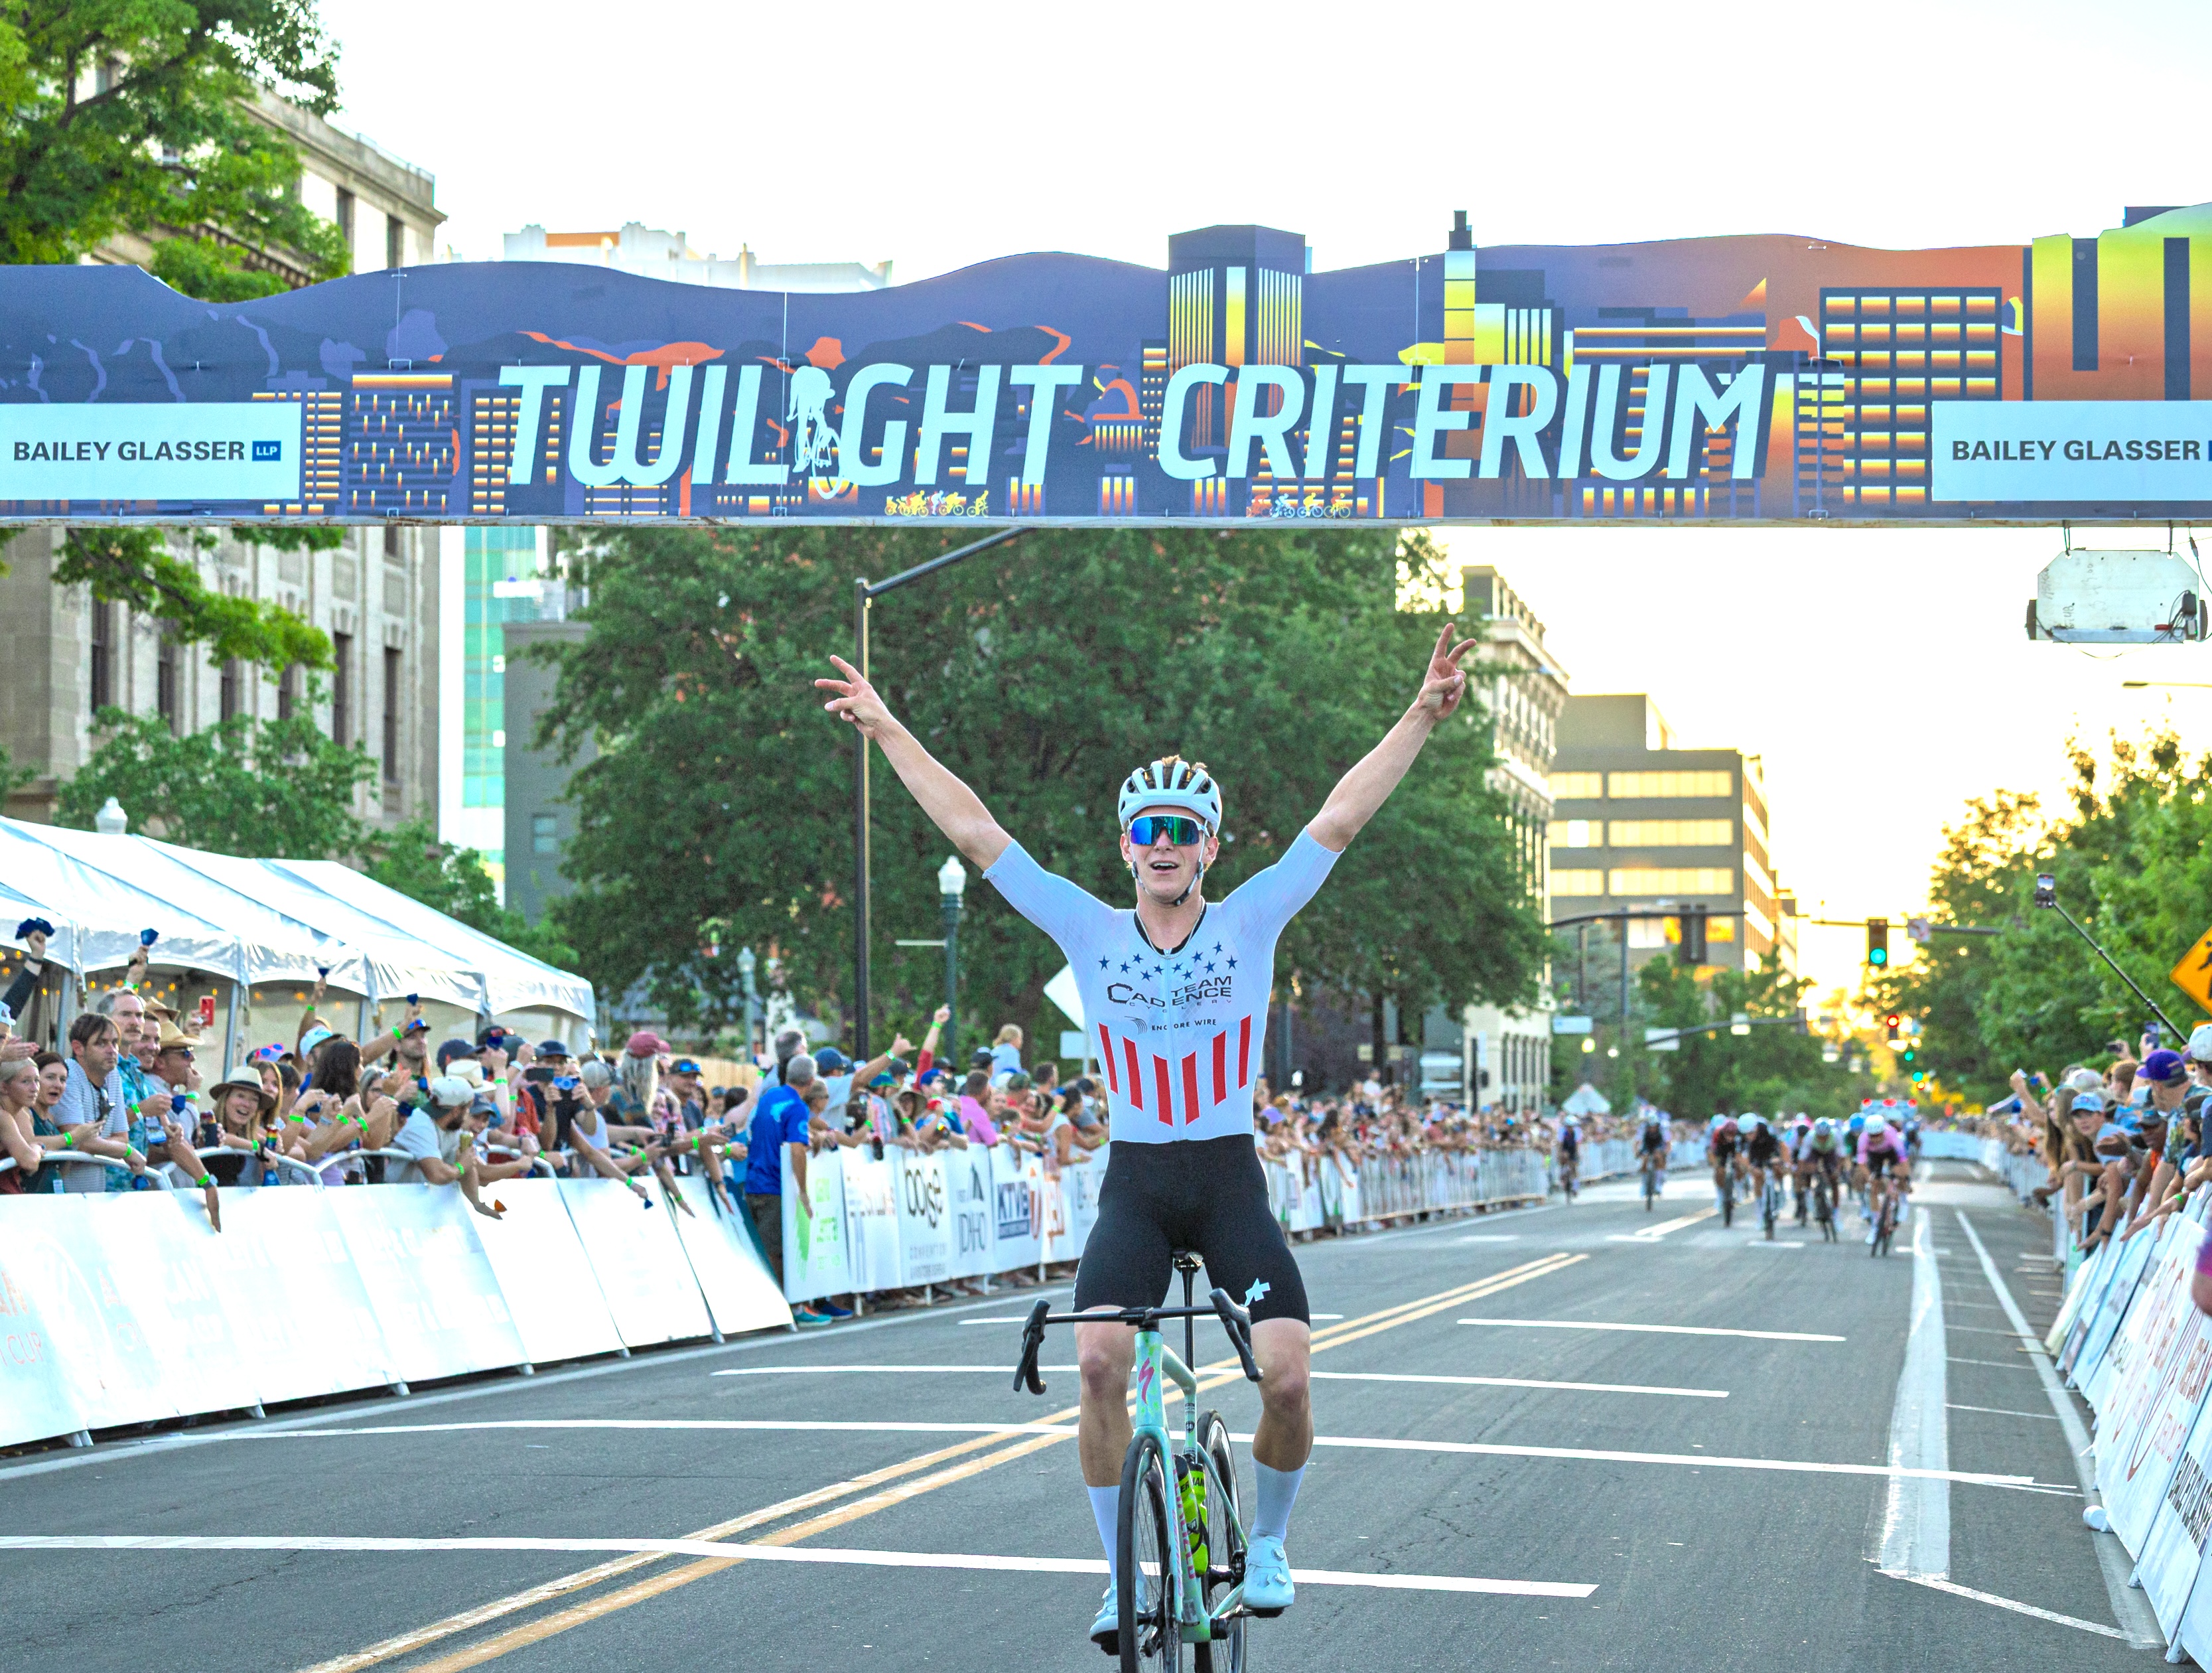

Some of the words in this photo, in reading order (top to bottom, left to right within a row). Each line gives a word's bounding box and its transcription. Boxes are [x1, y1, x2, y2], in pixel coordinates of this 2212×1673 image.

[1157, 362, 1765, 480] CRITERIUM
[14, 441, 111, 461] BAILEY
[117, 441, 245, 461] GLASSER
[255, 446, 278, 457] LLP
[1953, 441, 2057, 461] BAILEY
[2063, 441, 2200, 461] GLASSER
[1170, 976, 1232, 997] TEAM
